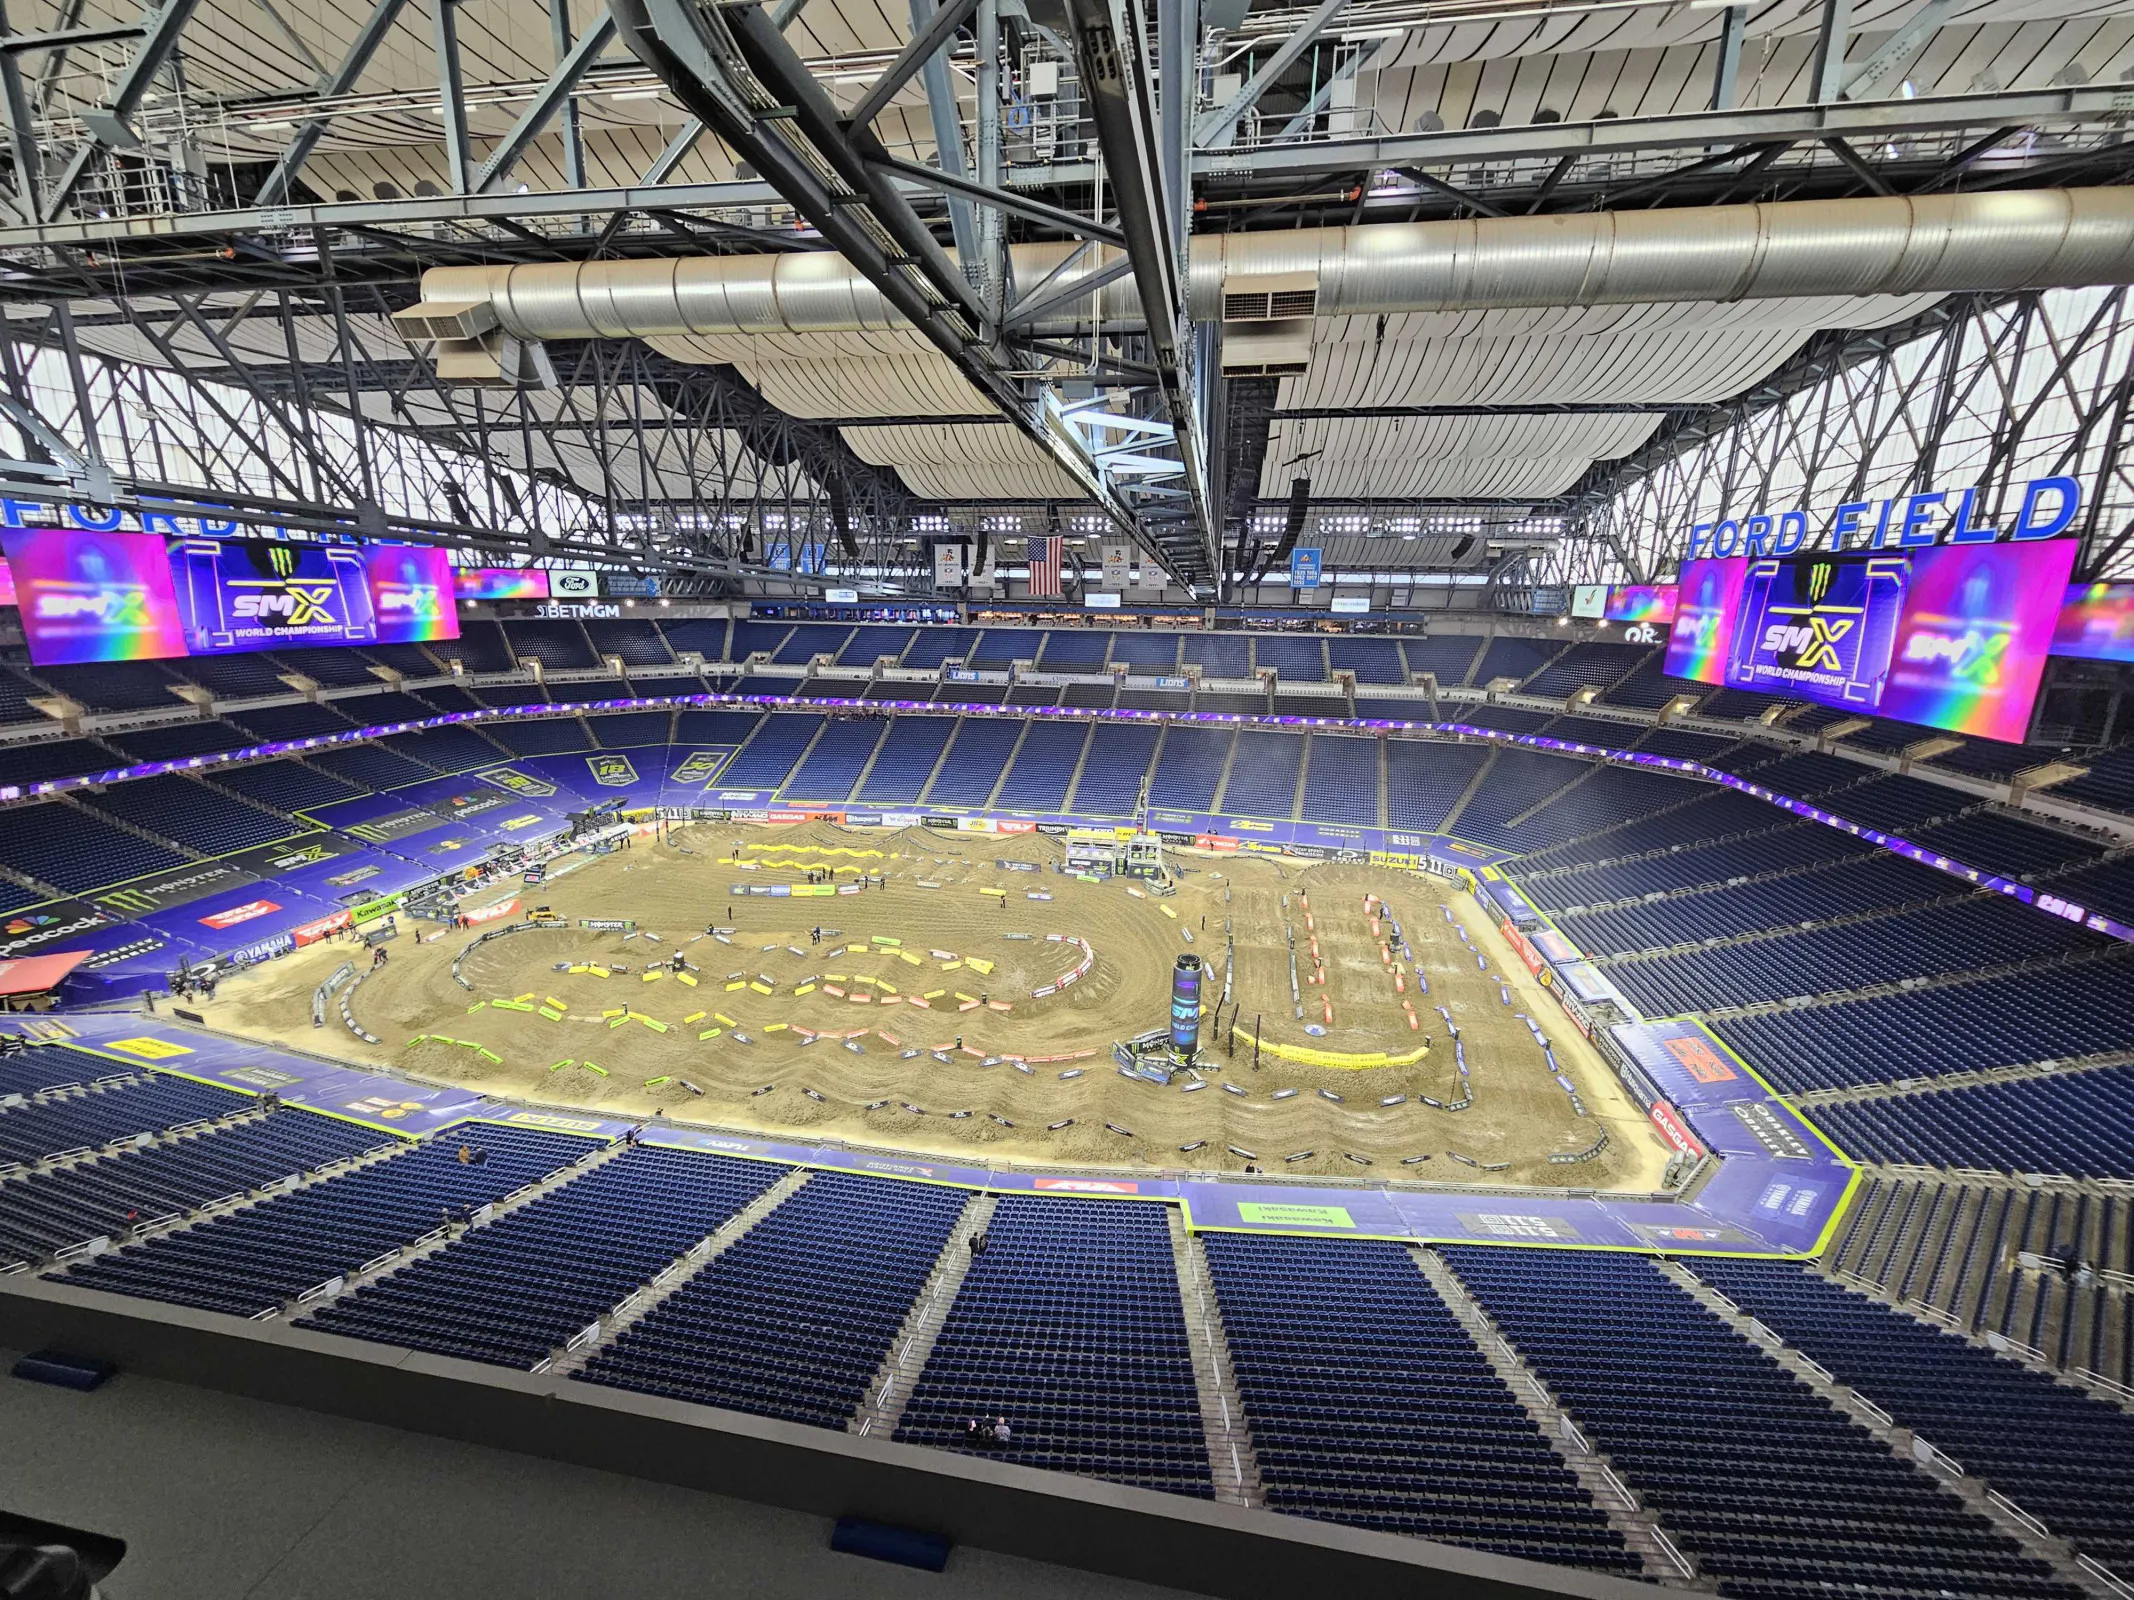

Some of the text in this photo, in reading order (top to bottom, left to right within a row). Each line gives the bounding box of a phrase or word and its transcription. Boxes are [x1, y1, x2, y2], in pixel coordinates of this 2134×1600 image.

[1687, 475, 2082, 560] FORD FIELD
[232, 587, 336, 624] SMX
[548, 604, 620, 618] BETMGM
[235, 625, 343, 638] WORLD CHAMPIONSHIP
[1760, 617, 1856, 671] SMX
[1755, 664, 1847, 687] WORLD CHAMPIONSHIP
[600, 764, 626, 776] 18
[453, 797, 504, 818] peacock
[769, 813, 806, 821] GASGAS
[815, 813, 838, 823] KTM
[1038, 824, 1065, 833] TRIUMPH
[1372, 854, 1418, 867] SUZUKI
[143, 867, 231, 895] MONSTER
[356, 898, 398, 919] Kawasak
[247, 934, 293, 959] YAMAHA
[512, 1113, 592, 1130] SUZUKI
[1745, 1118, 1787, 1157] OAKLEY
[1766, 1116, 1810, 1155] OAKLEY
